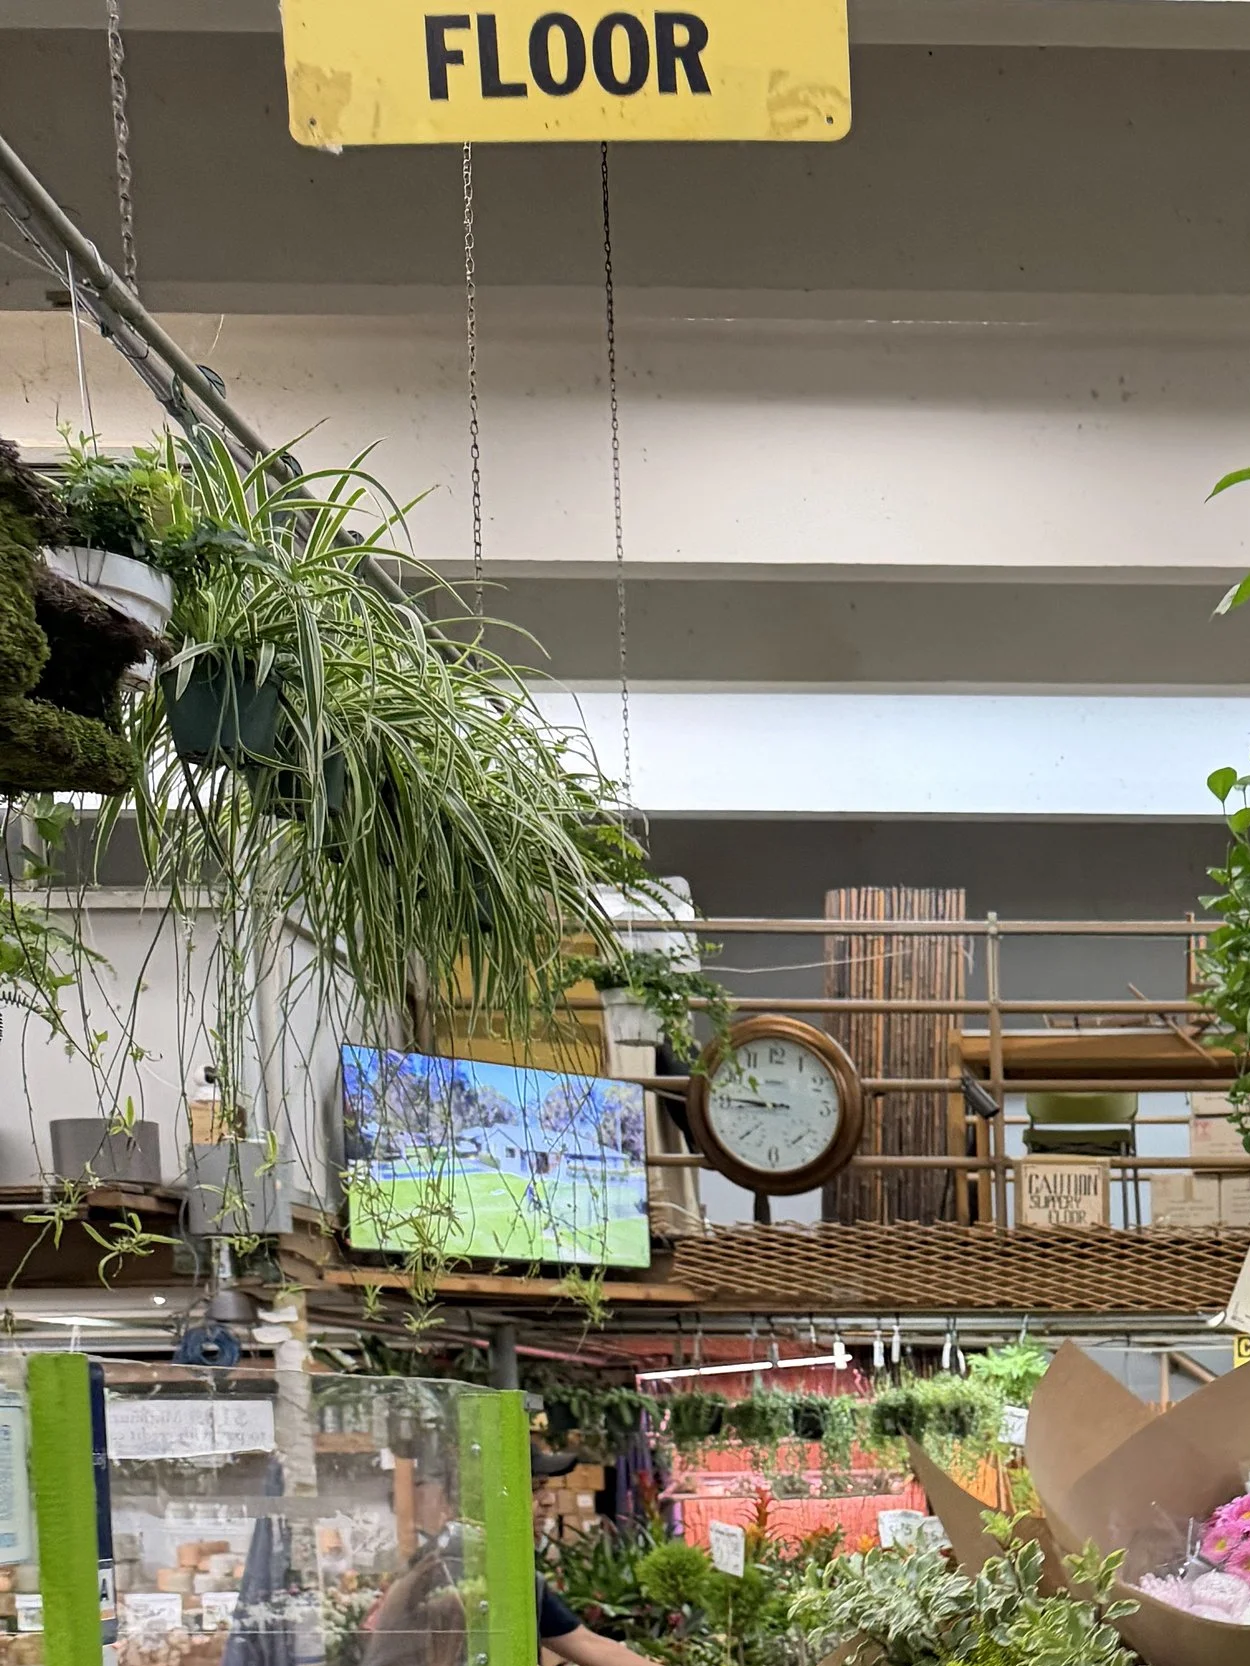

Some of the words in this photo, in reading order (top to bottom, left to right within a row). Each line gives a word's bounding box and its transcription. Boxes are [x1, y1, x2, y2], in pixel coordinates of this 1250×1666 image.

[425, 10, 713, 102] FLOOR
[769, 1047, 786, 1065] 12
[811, 1075, 824, 1093] 2
[1028, 1173, 1099, 1197] CAUTION
